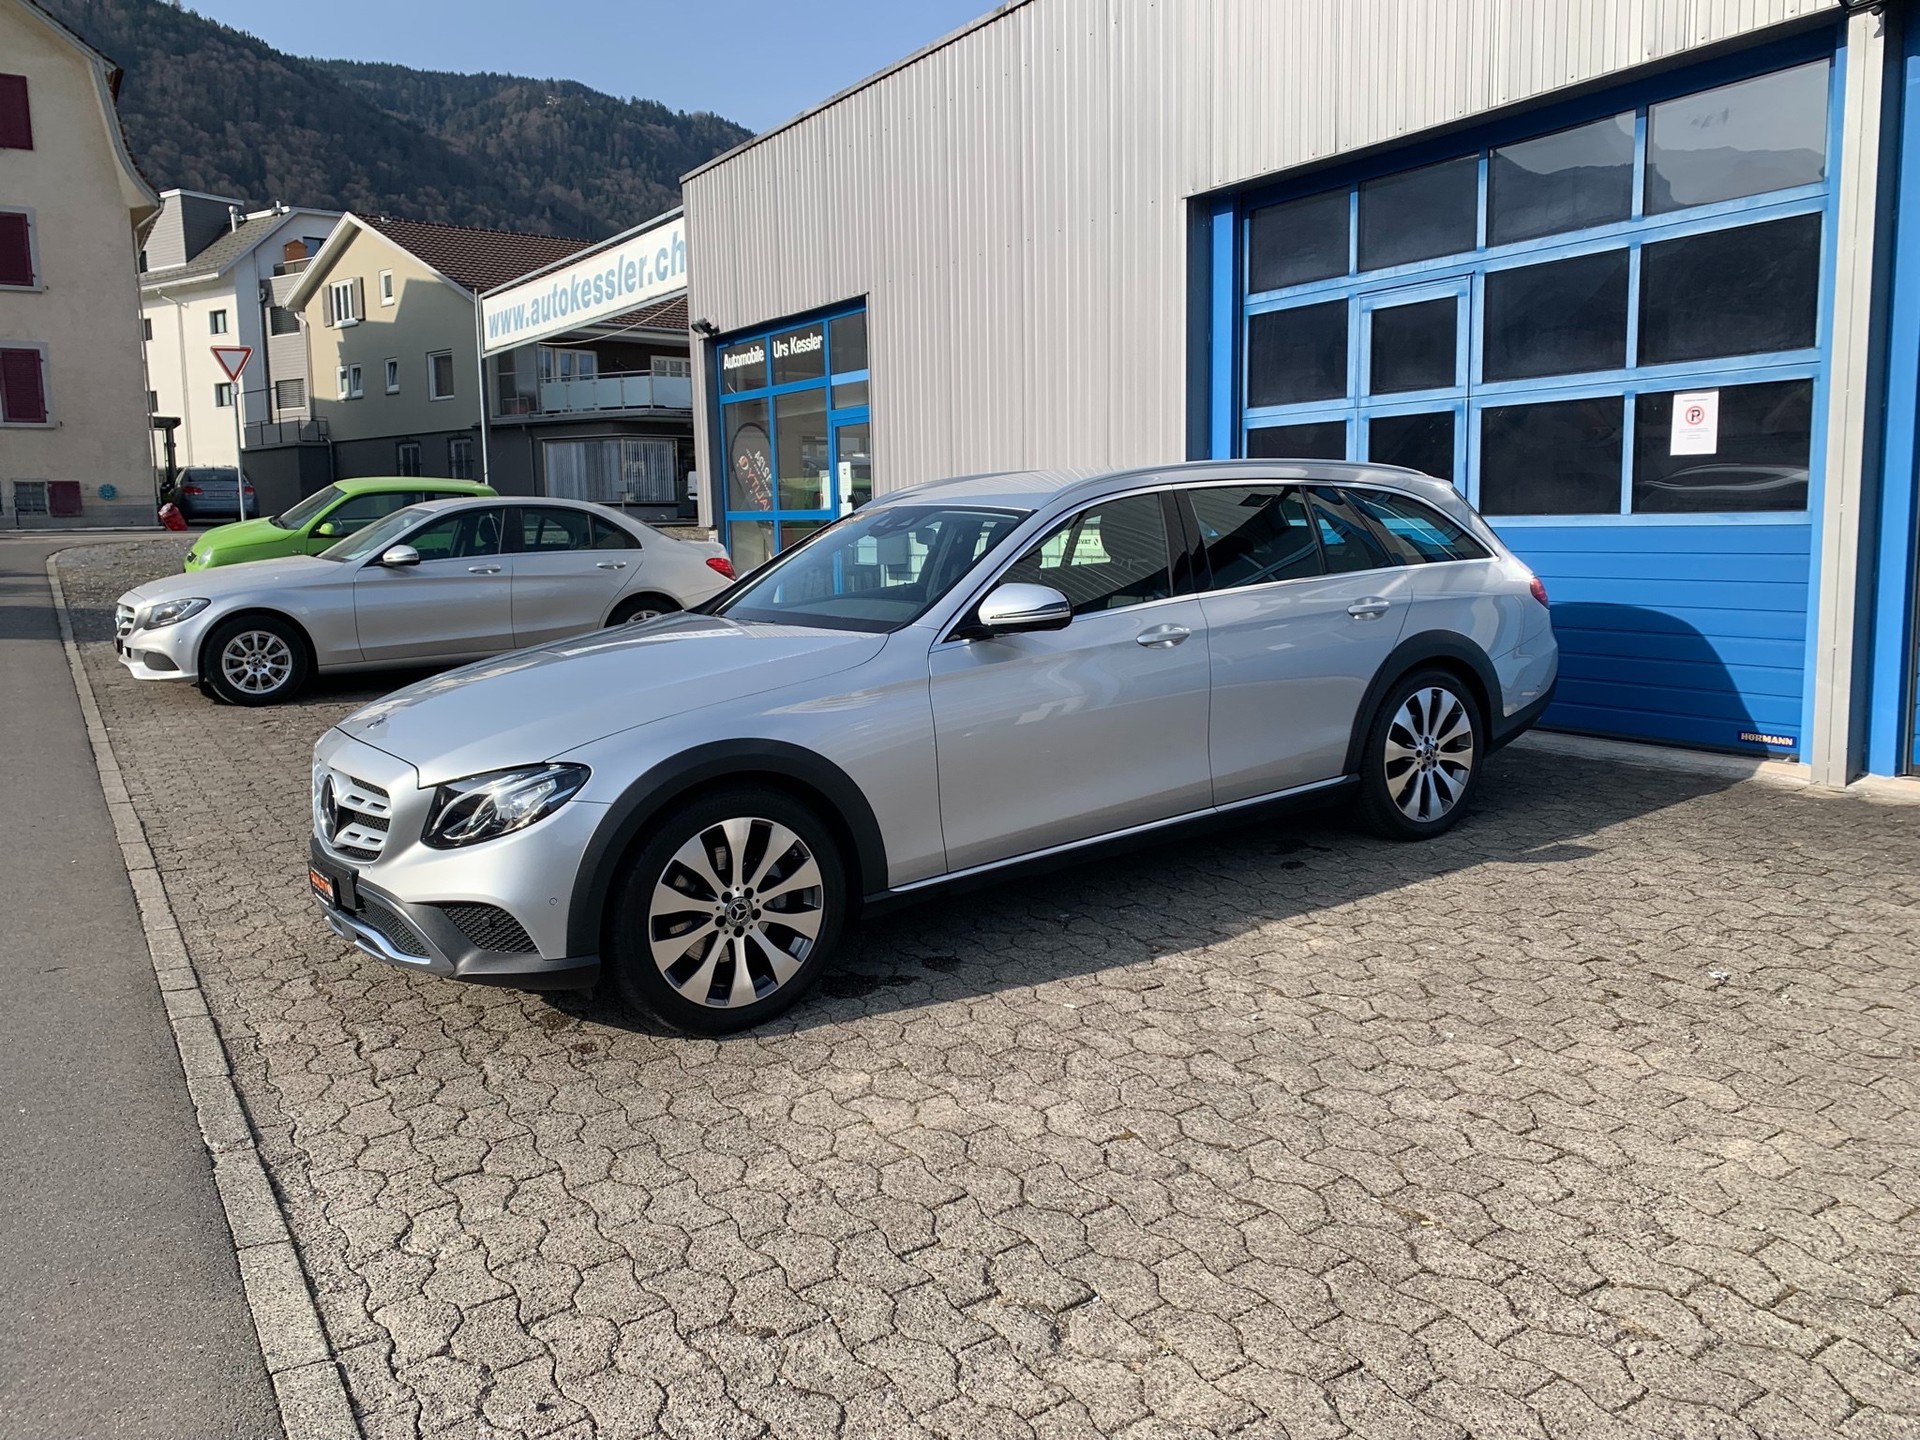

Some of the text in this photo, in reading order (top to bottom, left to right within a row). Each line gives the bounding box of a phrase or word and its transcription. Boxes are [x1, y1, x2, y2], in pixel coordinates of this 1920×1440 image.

[489, 231, 685, 338] www.autokessler.ch
[723, 332, 823, 370] Automobile Urs Kessler
